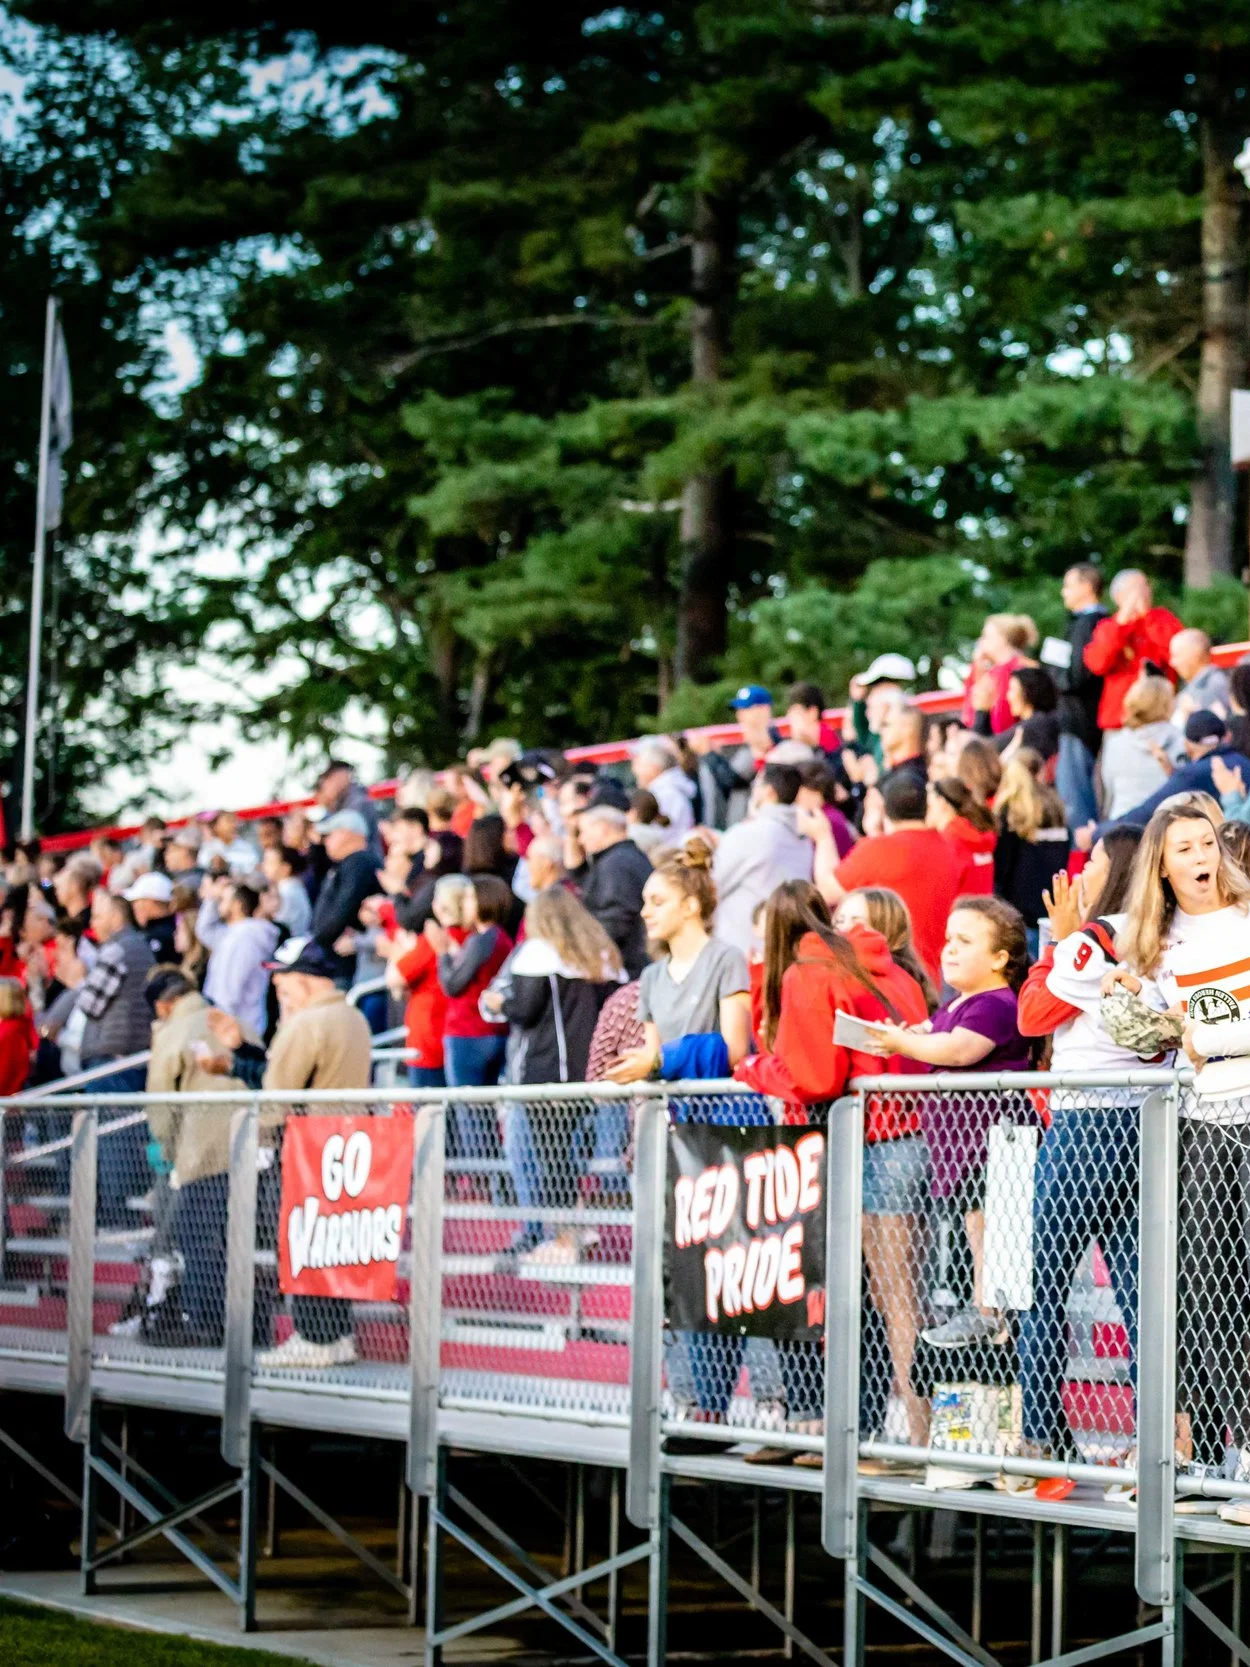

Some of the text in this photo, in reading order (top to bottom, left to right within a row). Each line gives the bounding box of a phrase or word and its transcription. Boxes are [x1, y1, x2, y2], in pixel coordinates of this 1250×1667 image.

[1073, 942, 1093, 972] 9
[321, 1130, 373, 1202] GO
[675, 1131, 825, 1249] RED TIDE
[288, 1196, 402, 1279] WARRIORS
[704, 1222, 805, 1324] PRIDE
